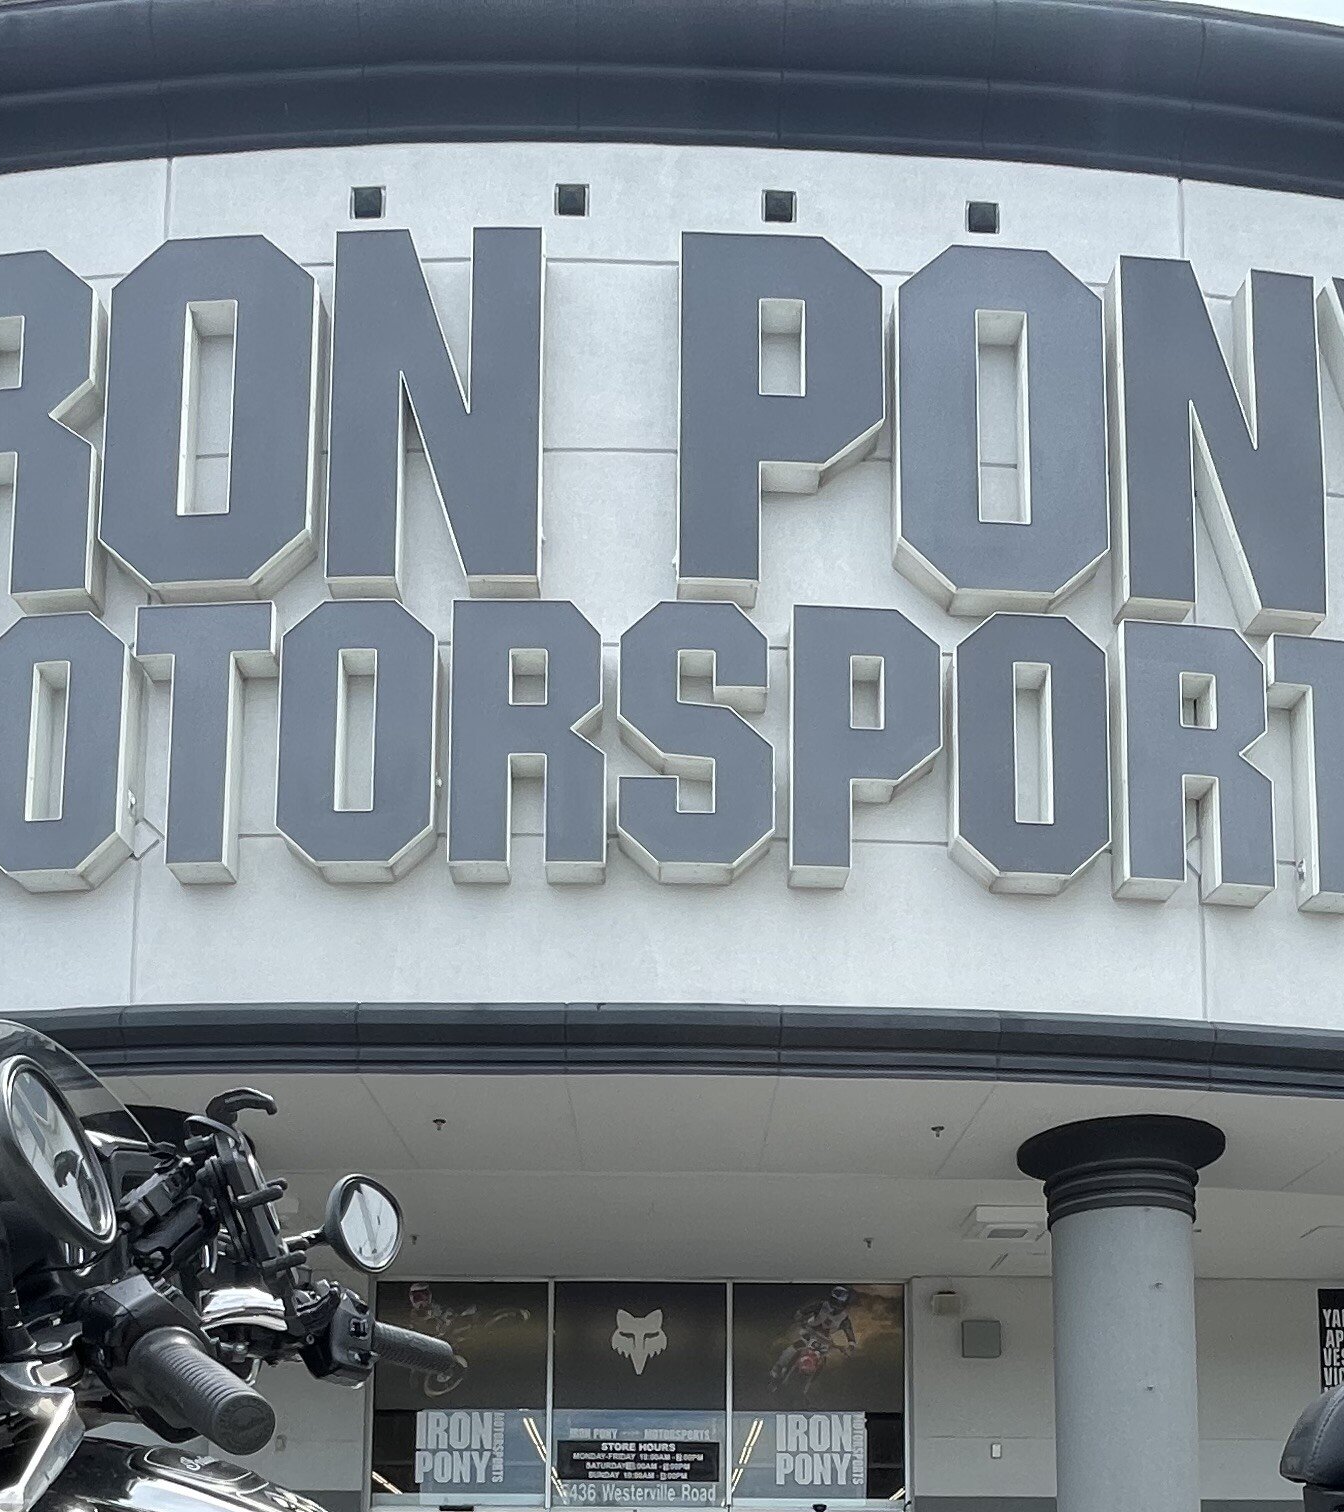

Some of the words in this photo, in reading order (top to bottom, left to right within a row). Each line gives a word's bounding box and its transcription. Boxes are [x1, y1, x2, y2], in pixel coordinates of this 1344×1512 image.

[416, 1411, 493, 1449] IRON
[776, 1414, 852, 1452] IRON
[601, 1442, 636, 1452] STORE
[638, 1443, 676, 1452] HOURS
[415, 1450, 491, 1483] PONY
[776, 1452, 852, 1485] PONY
[602, 1483, 676, 1502] Westerville
[681, 1484, 716, 1502] Road
